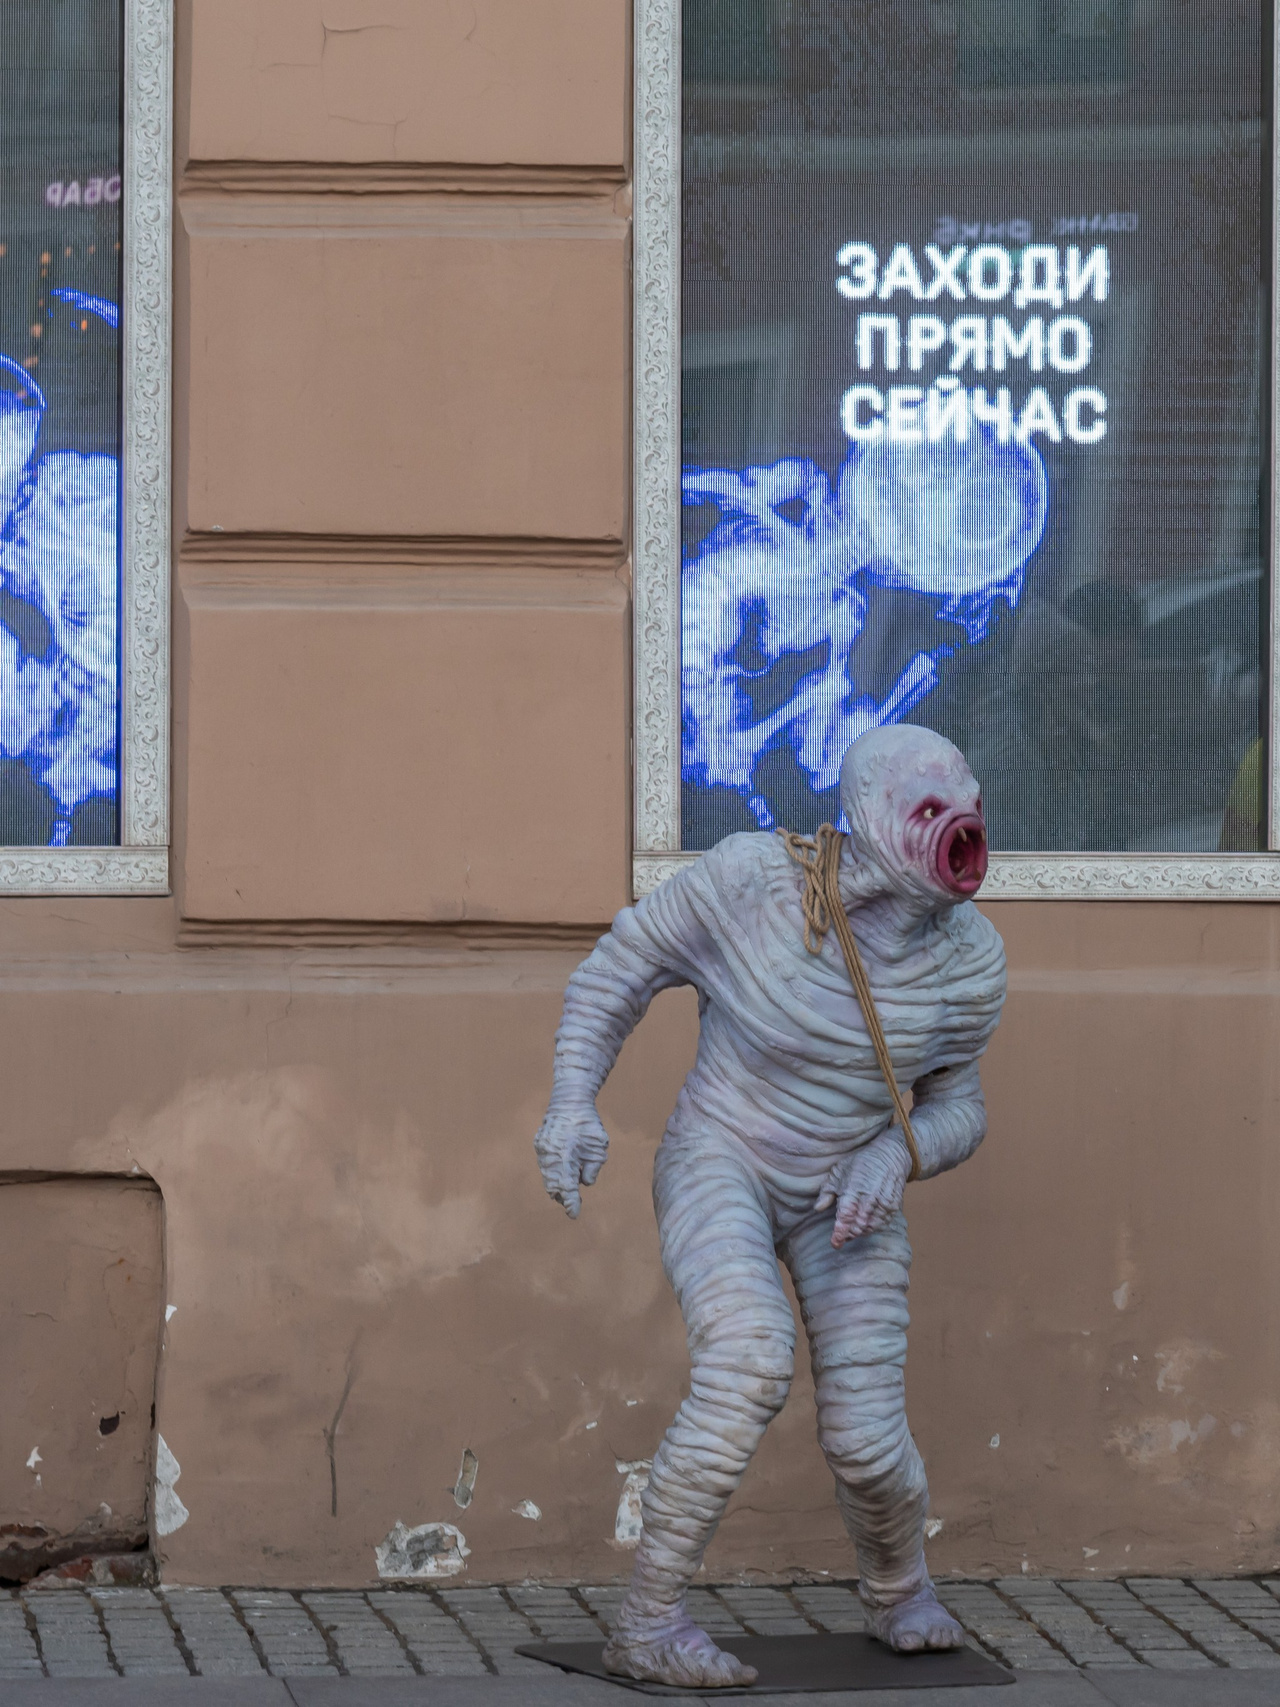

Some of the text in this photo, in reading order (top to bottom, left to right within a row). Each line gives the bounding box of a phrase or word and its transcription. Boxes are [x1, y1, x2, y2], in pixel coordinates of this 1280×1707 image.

[835, 241, 1111, 310] ЗАХОДИ
[855, 313, 1093, 374] ПРЯМО
[840, 375, 1109, 445] СЕЙЧАС
